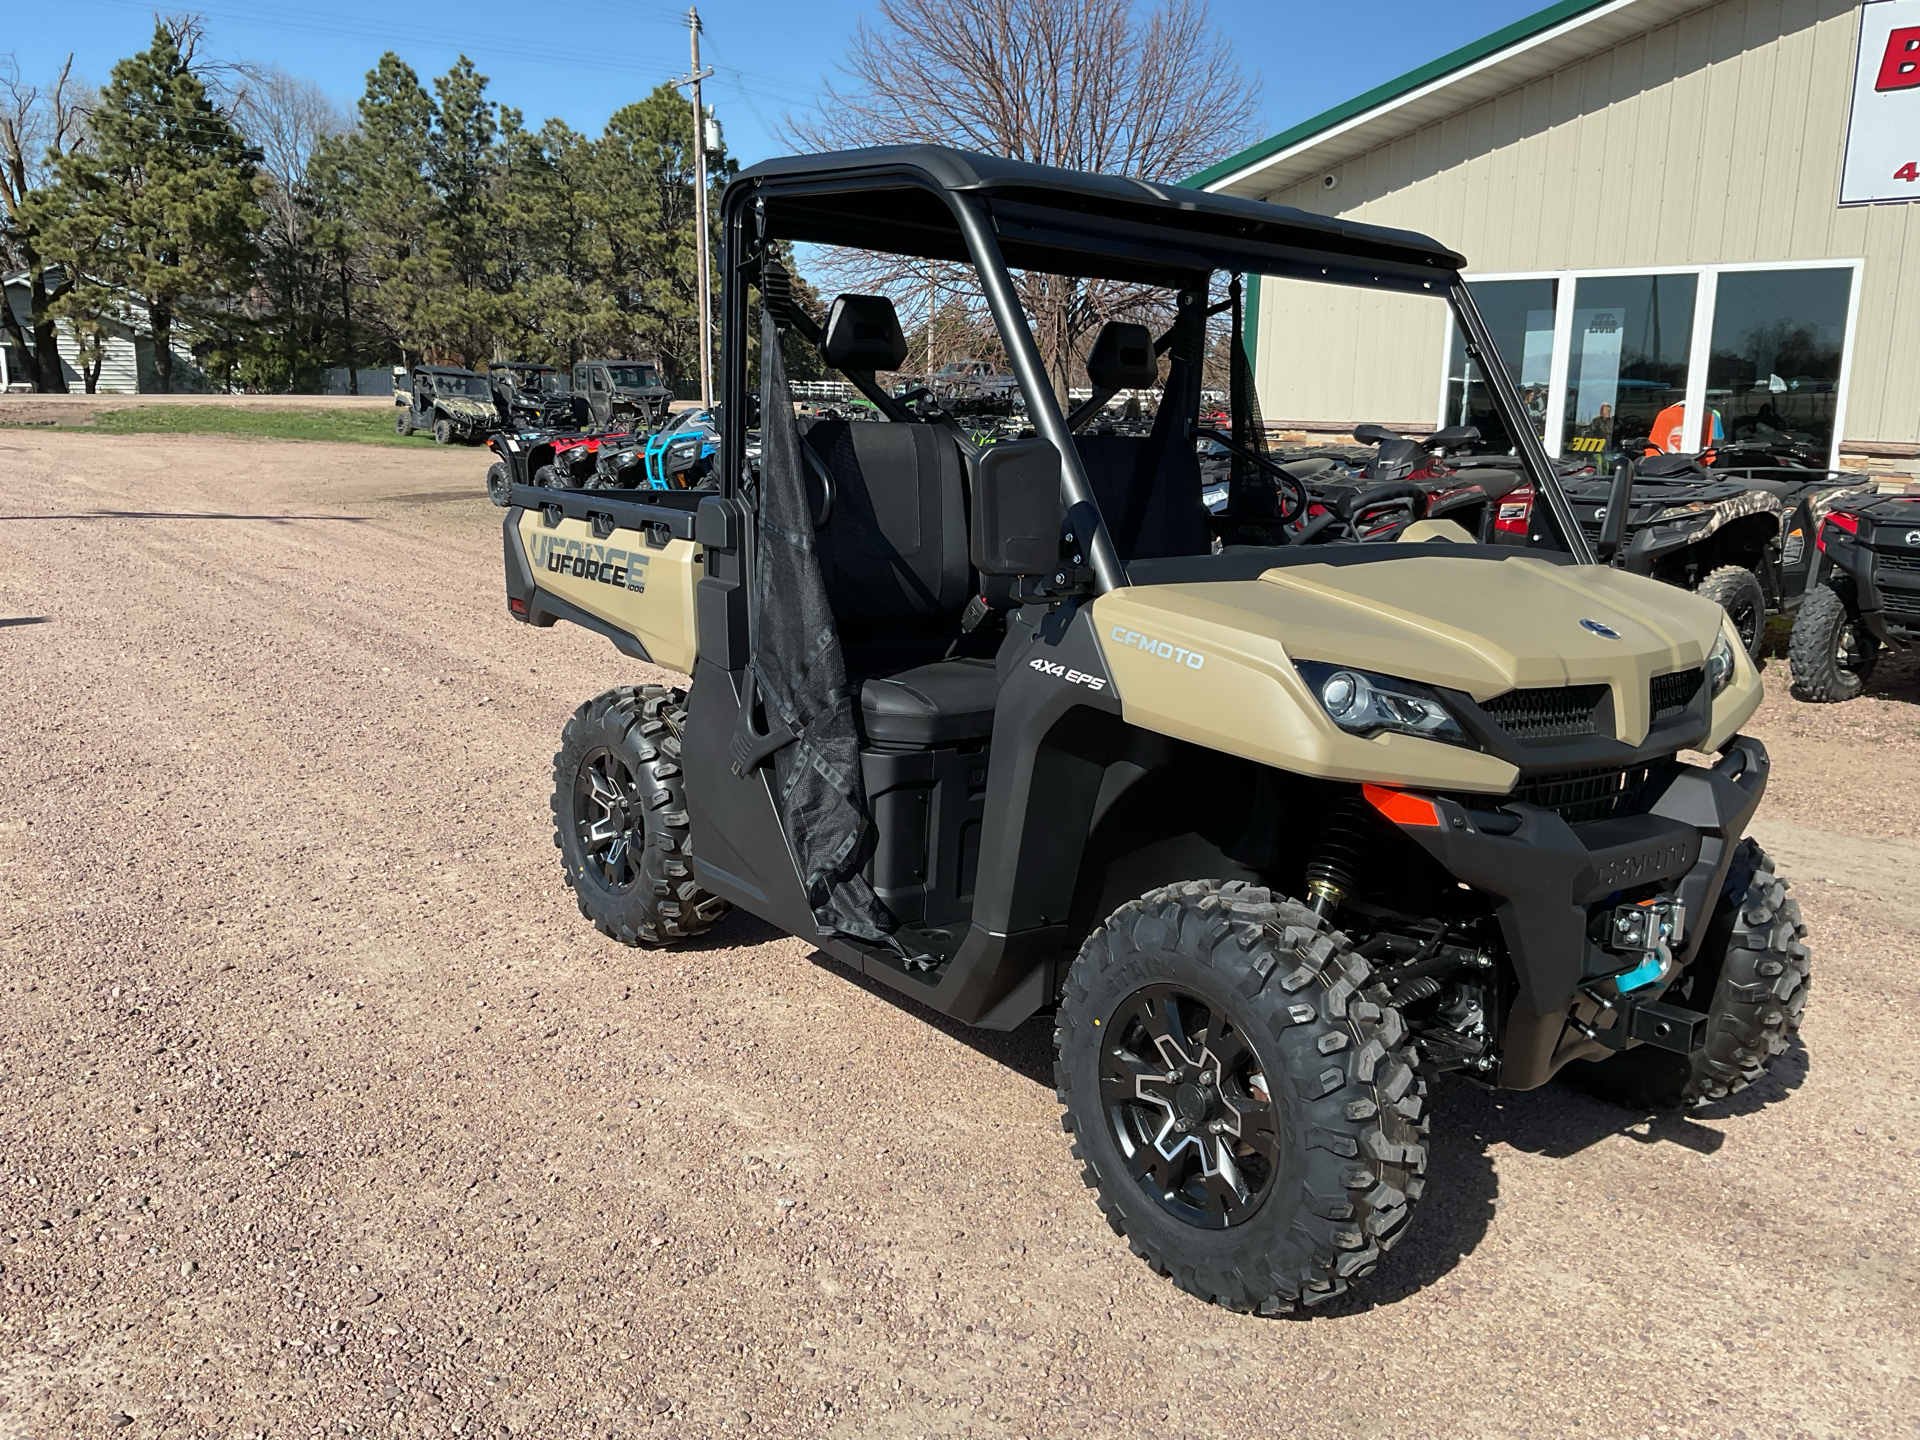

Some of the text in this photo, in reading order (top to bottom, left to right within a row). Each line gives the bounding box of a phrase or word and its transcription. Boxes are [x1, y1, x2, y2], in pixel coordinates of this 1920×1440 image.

[549, 552, 629, 588] UFORCE
[627, 584, 645, 593] 1000
[1110, 626, 1204, 670] CFMOTO
[1029, 658, 1107, 691] 4X4 EPS
